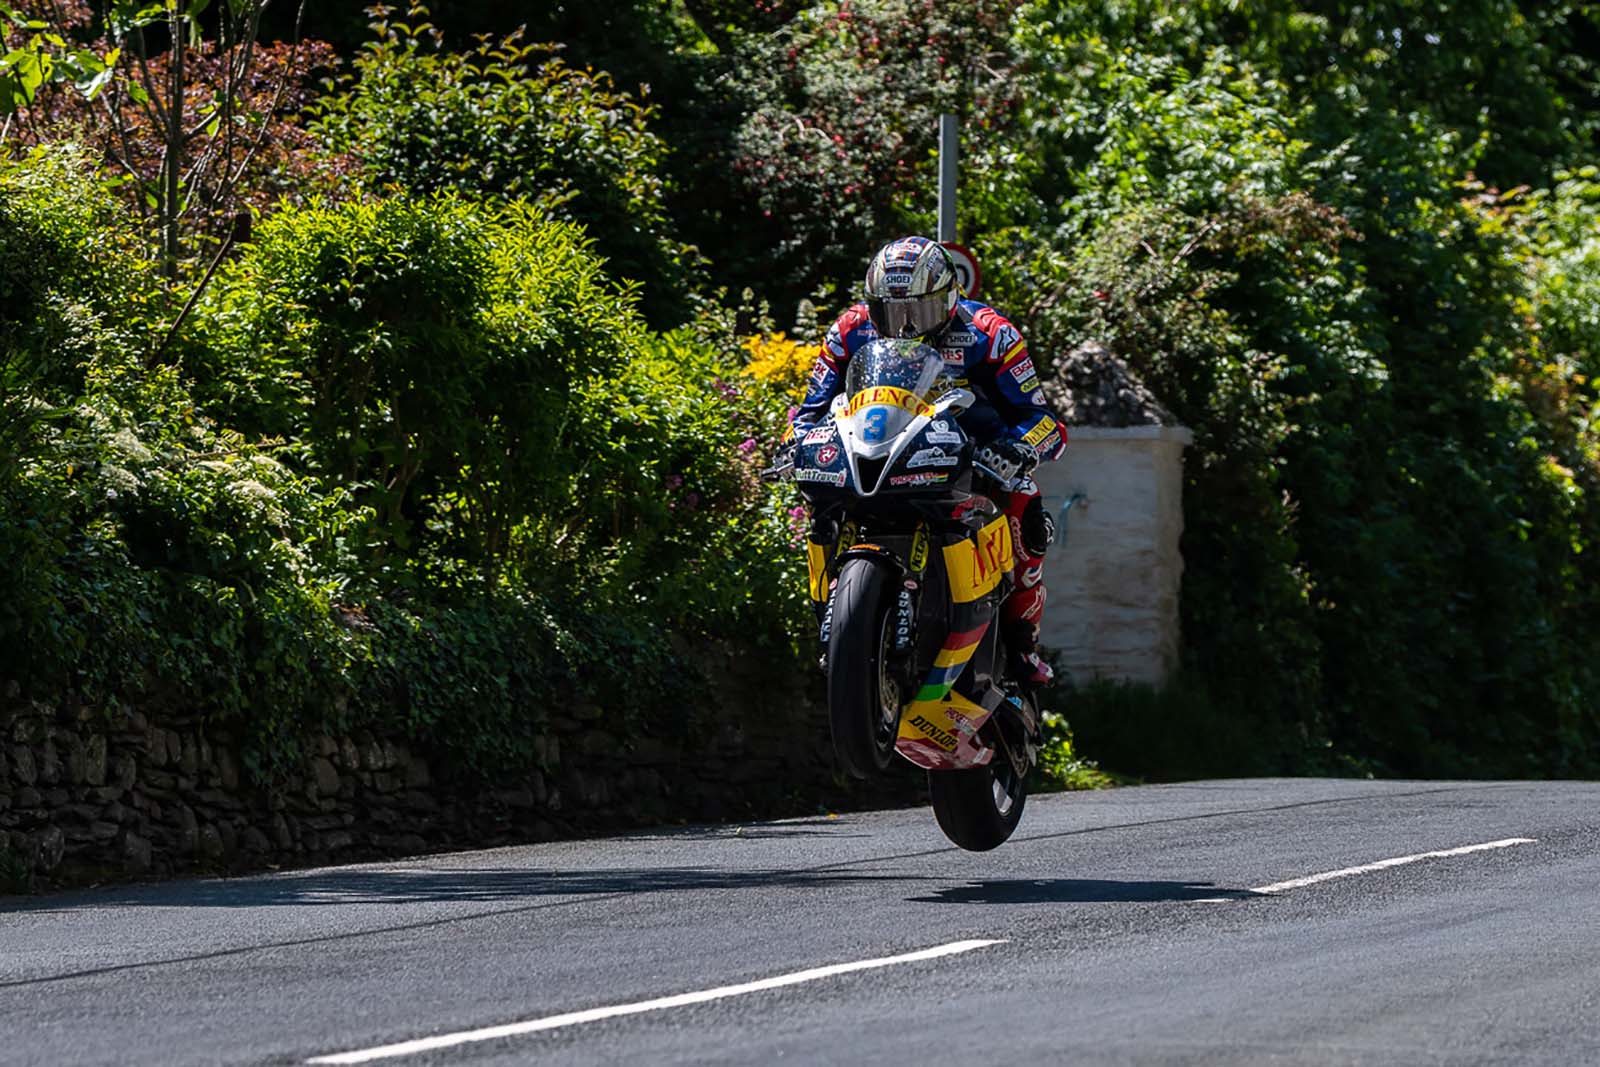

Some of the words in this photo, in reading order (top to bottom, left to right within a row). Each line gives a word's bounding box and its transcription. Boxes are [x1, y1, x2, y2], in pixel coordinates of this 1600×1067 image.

[886, 275, 911, 284] SHOEI
[863, 407, 888, 442] 3
[909, 715, 959, 748] DUNLOP
